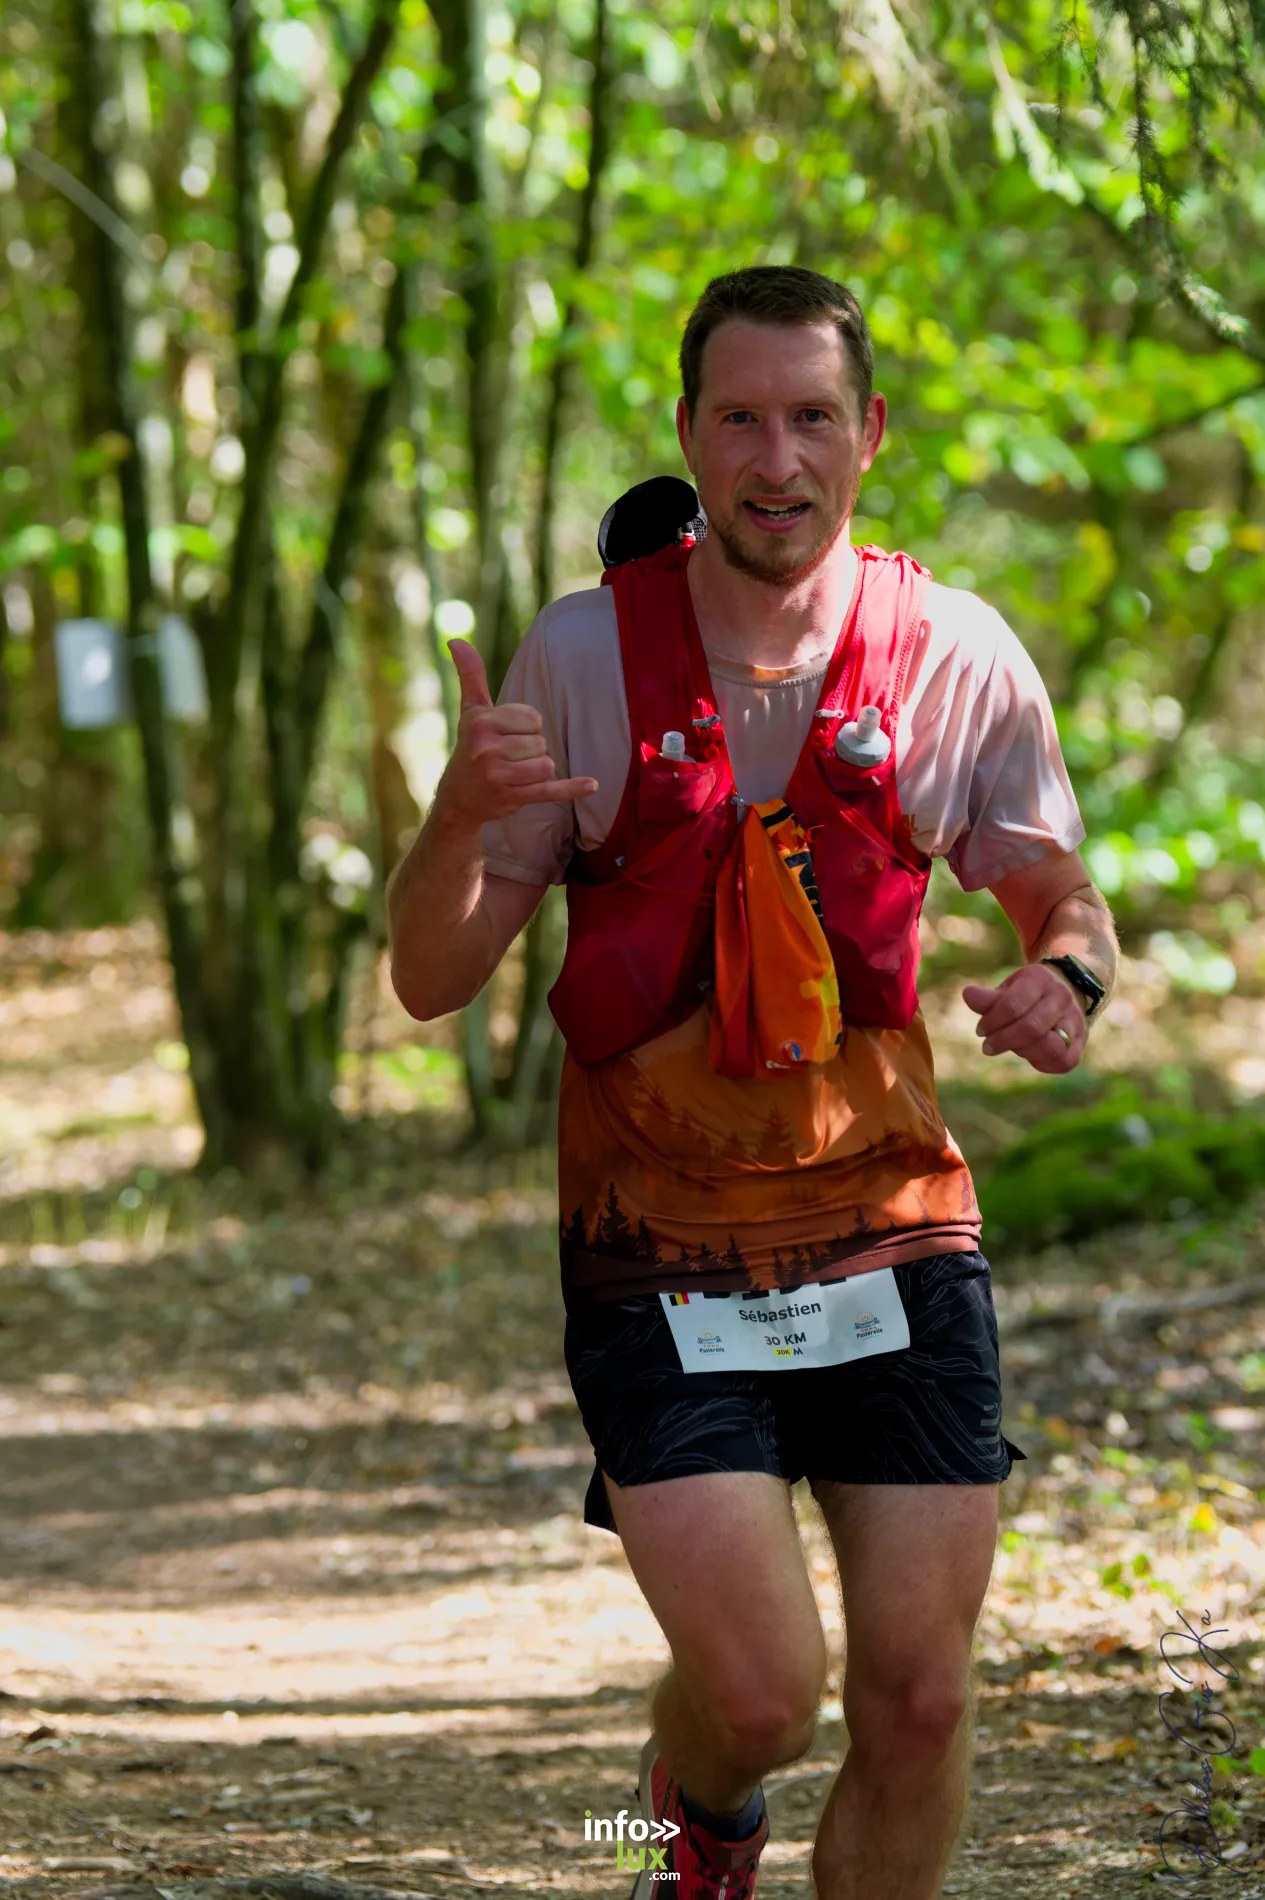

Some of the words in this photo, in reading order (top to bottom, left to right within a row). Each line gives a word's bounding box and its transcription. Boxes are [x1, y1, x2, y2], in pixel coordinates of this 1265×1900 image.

[738, 1302, 822, 1323] Sébastien
[764, 1335, 781, 1346] 30
[784, 1331, 807, 1346] KM
